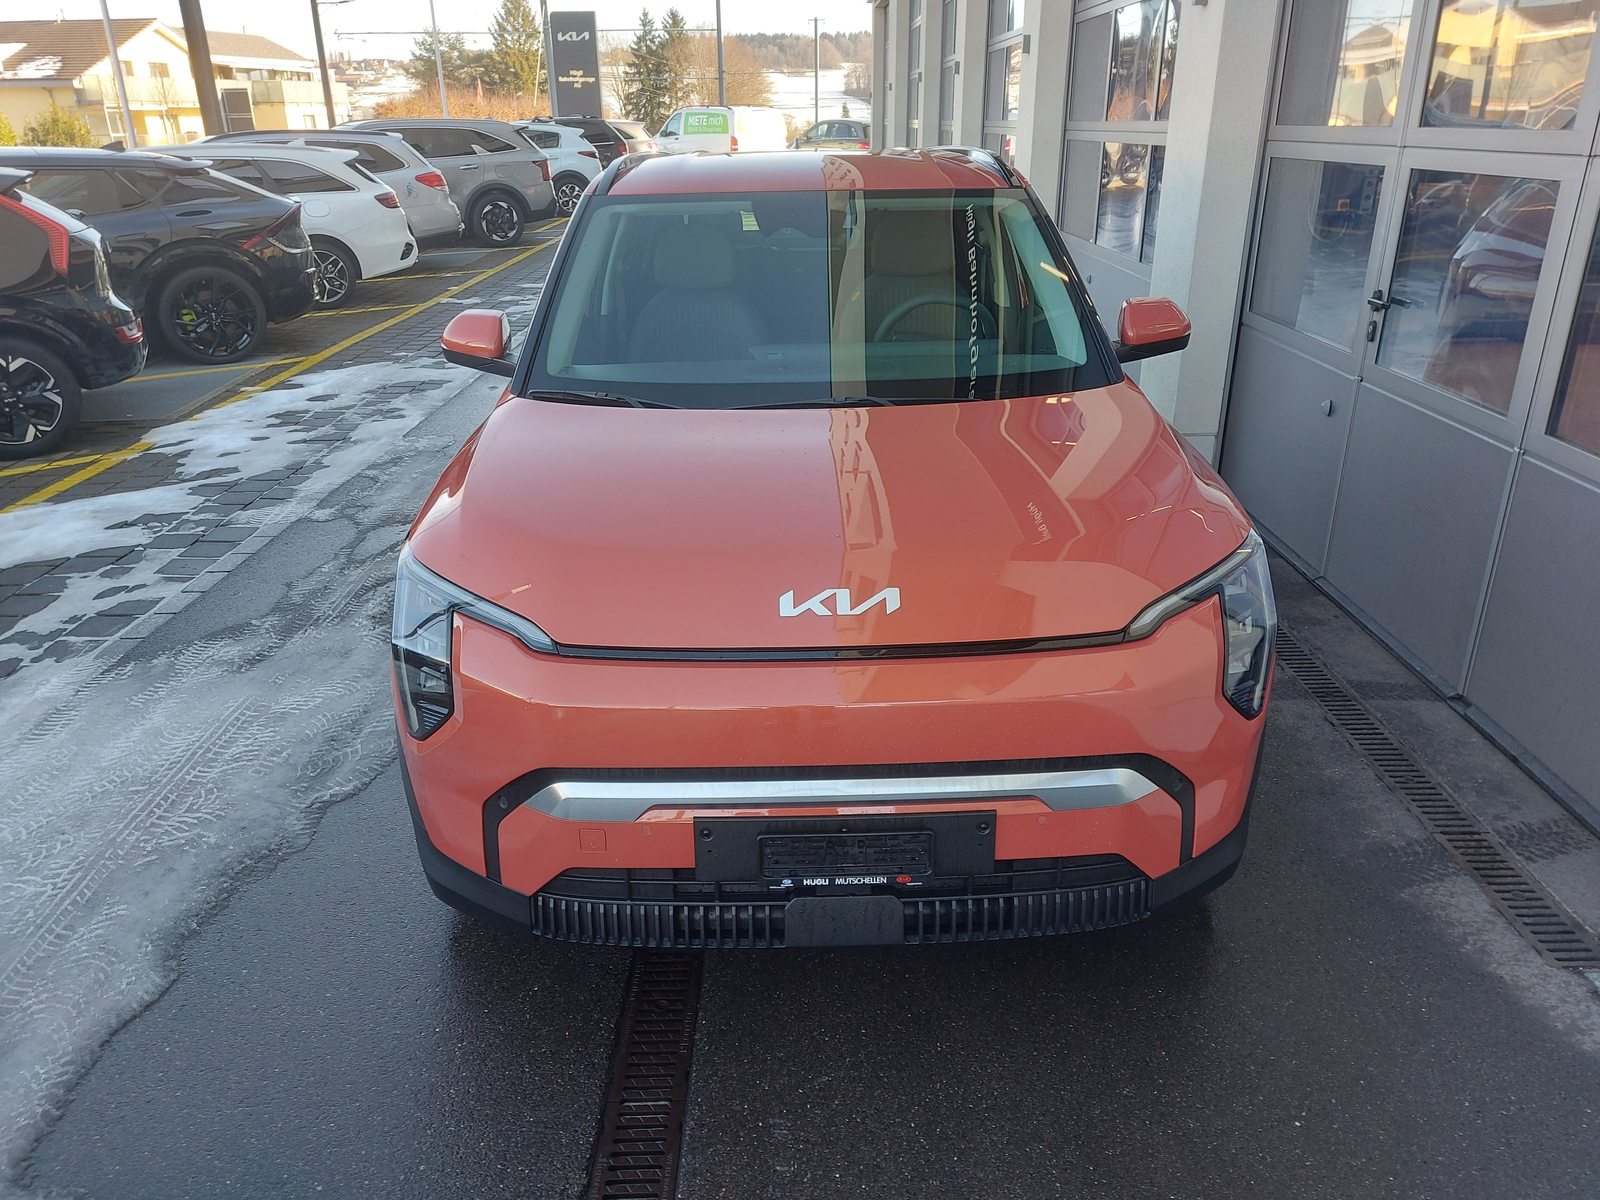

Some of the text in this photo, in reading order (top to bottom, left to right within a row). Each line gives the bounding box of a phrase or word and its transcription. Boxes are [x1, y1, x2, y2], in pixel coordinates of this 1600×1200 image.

[557, 31, 590, 41] KIA
[688, 114, 724, 126] MIETE mich
[779, 587, 901, 617] KIA
[835, 876, 887, 886] MUTSCHELLEN
